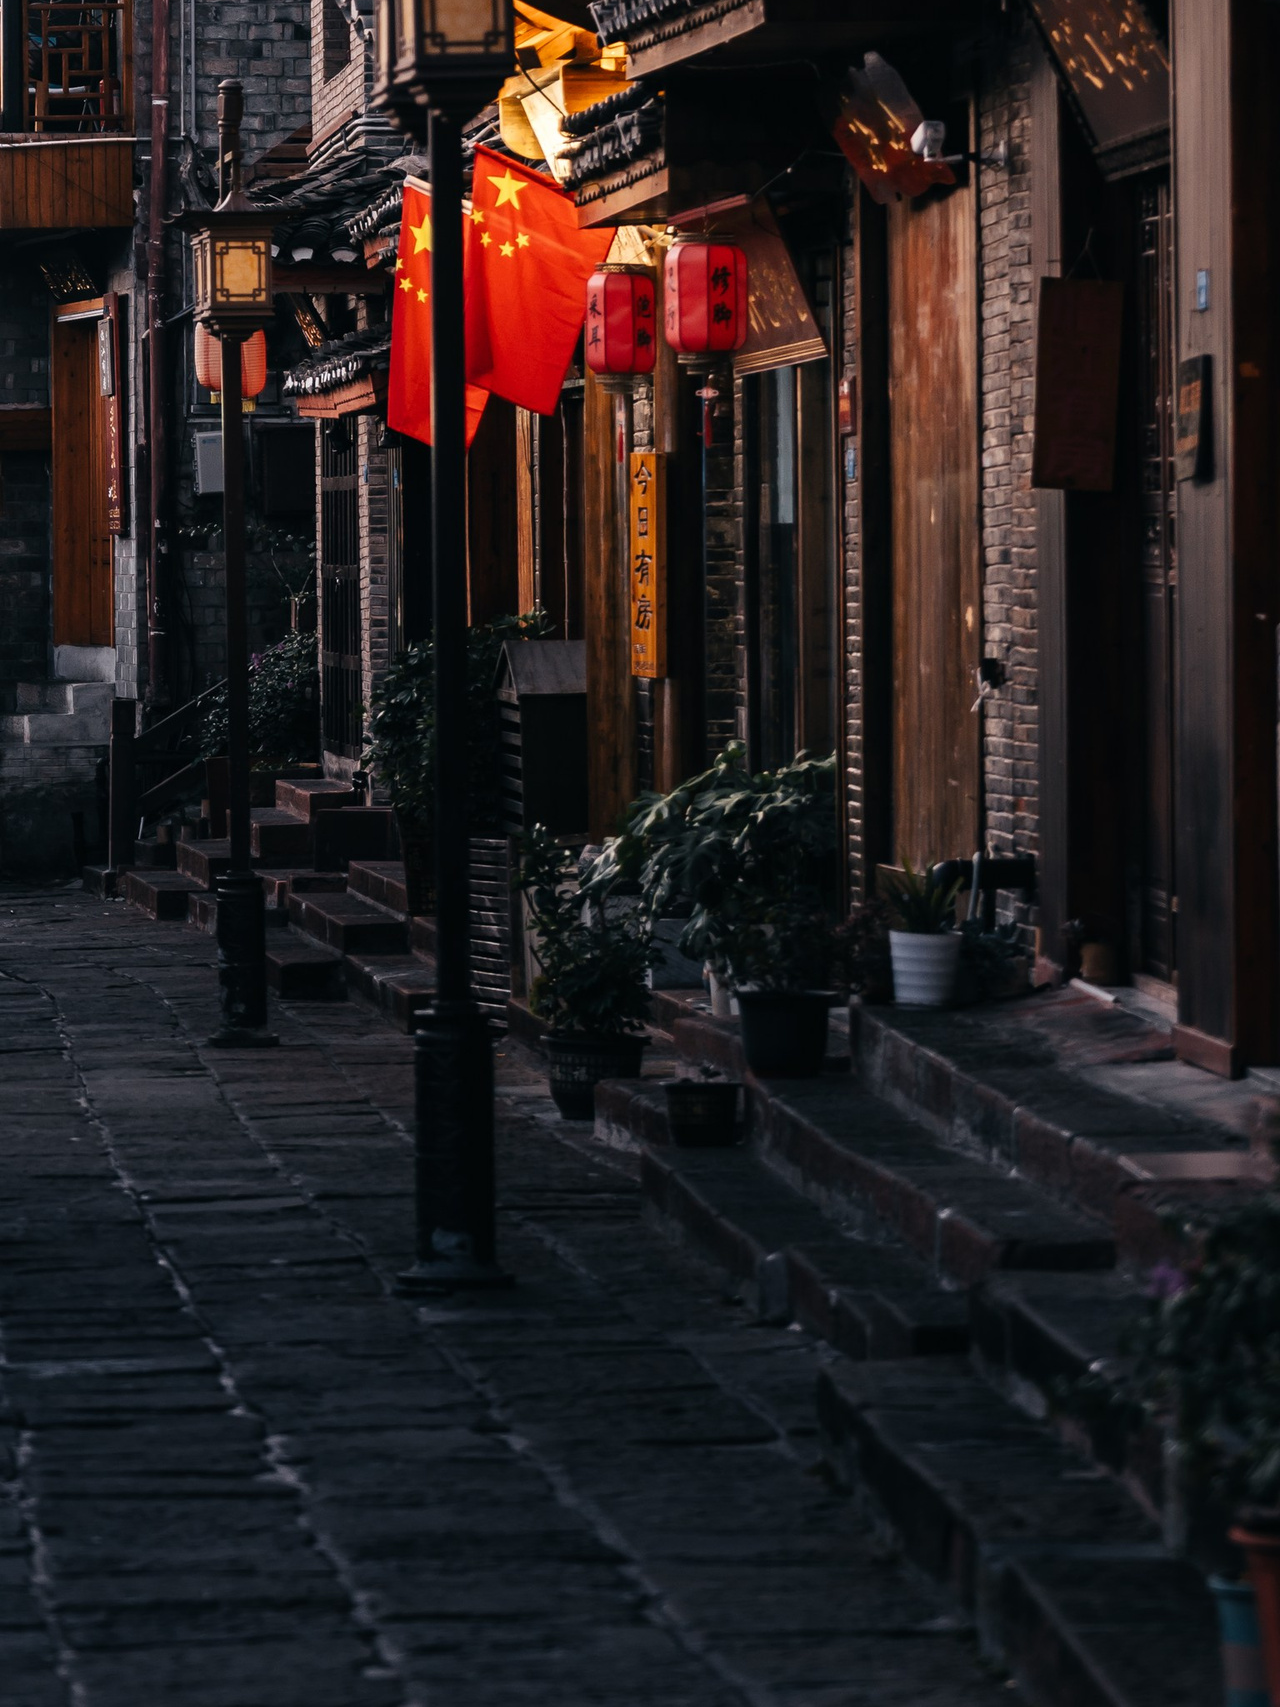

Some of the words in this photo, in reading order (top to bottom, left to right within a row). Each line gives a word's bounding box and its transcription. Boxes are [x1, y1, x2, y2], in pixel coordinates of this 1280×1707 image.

[588, 293, 602, 353] 采耳
[711, 266, 732, 331] 修脚
[633, 459, 653, 631] 今日有房
